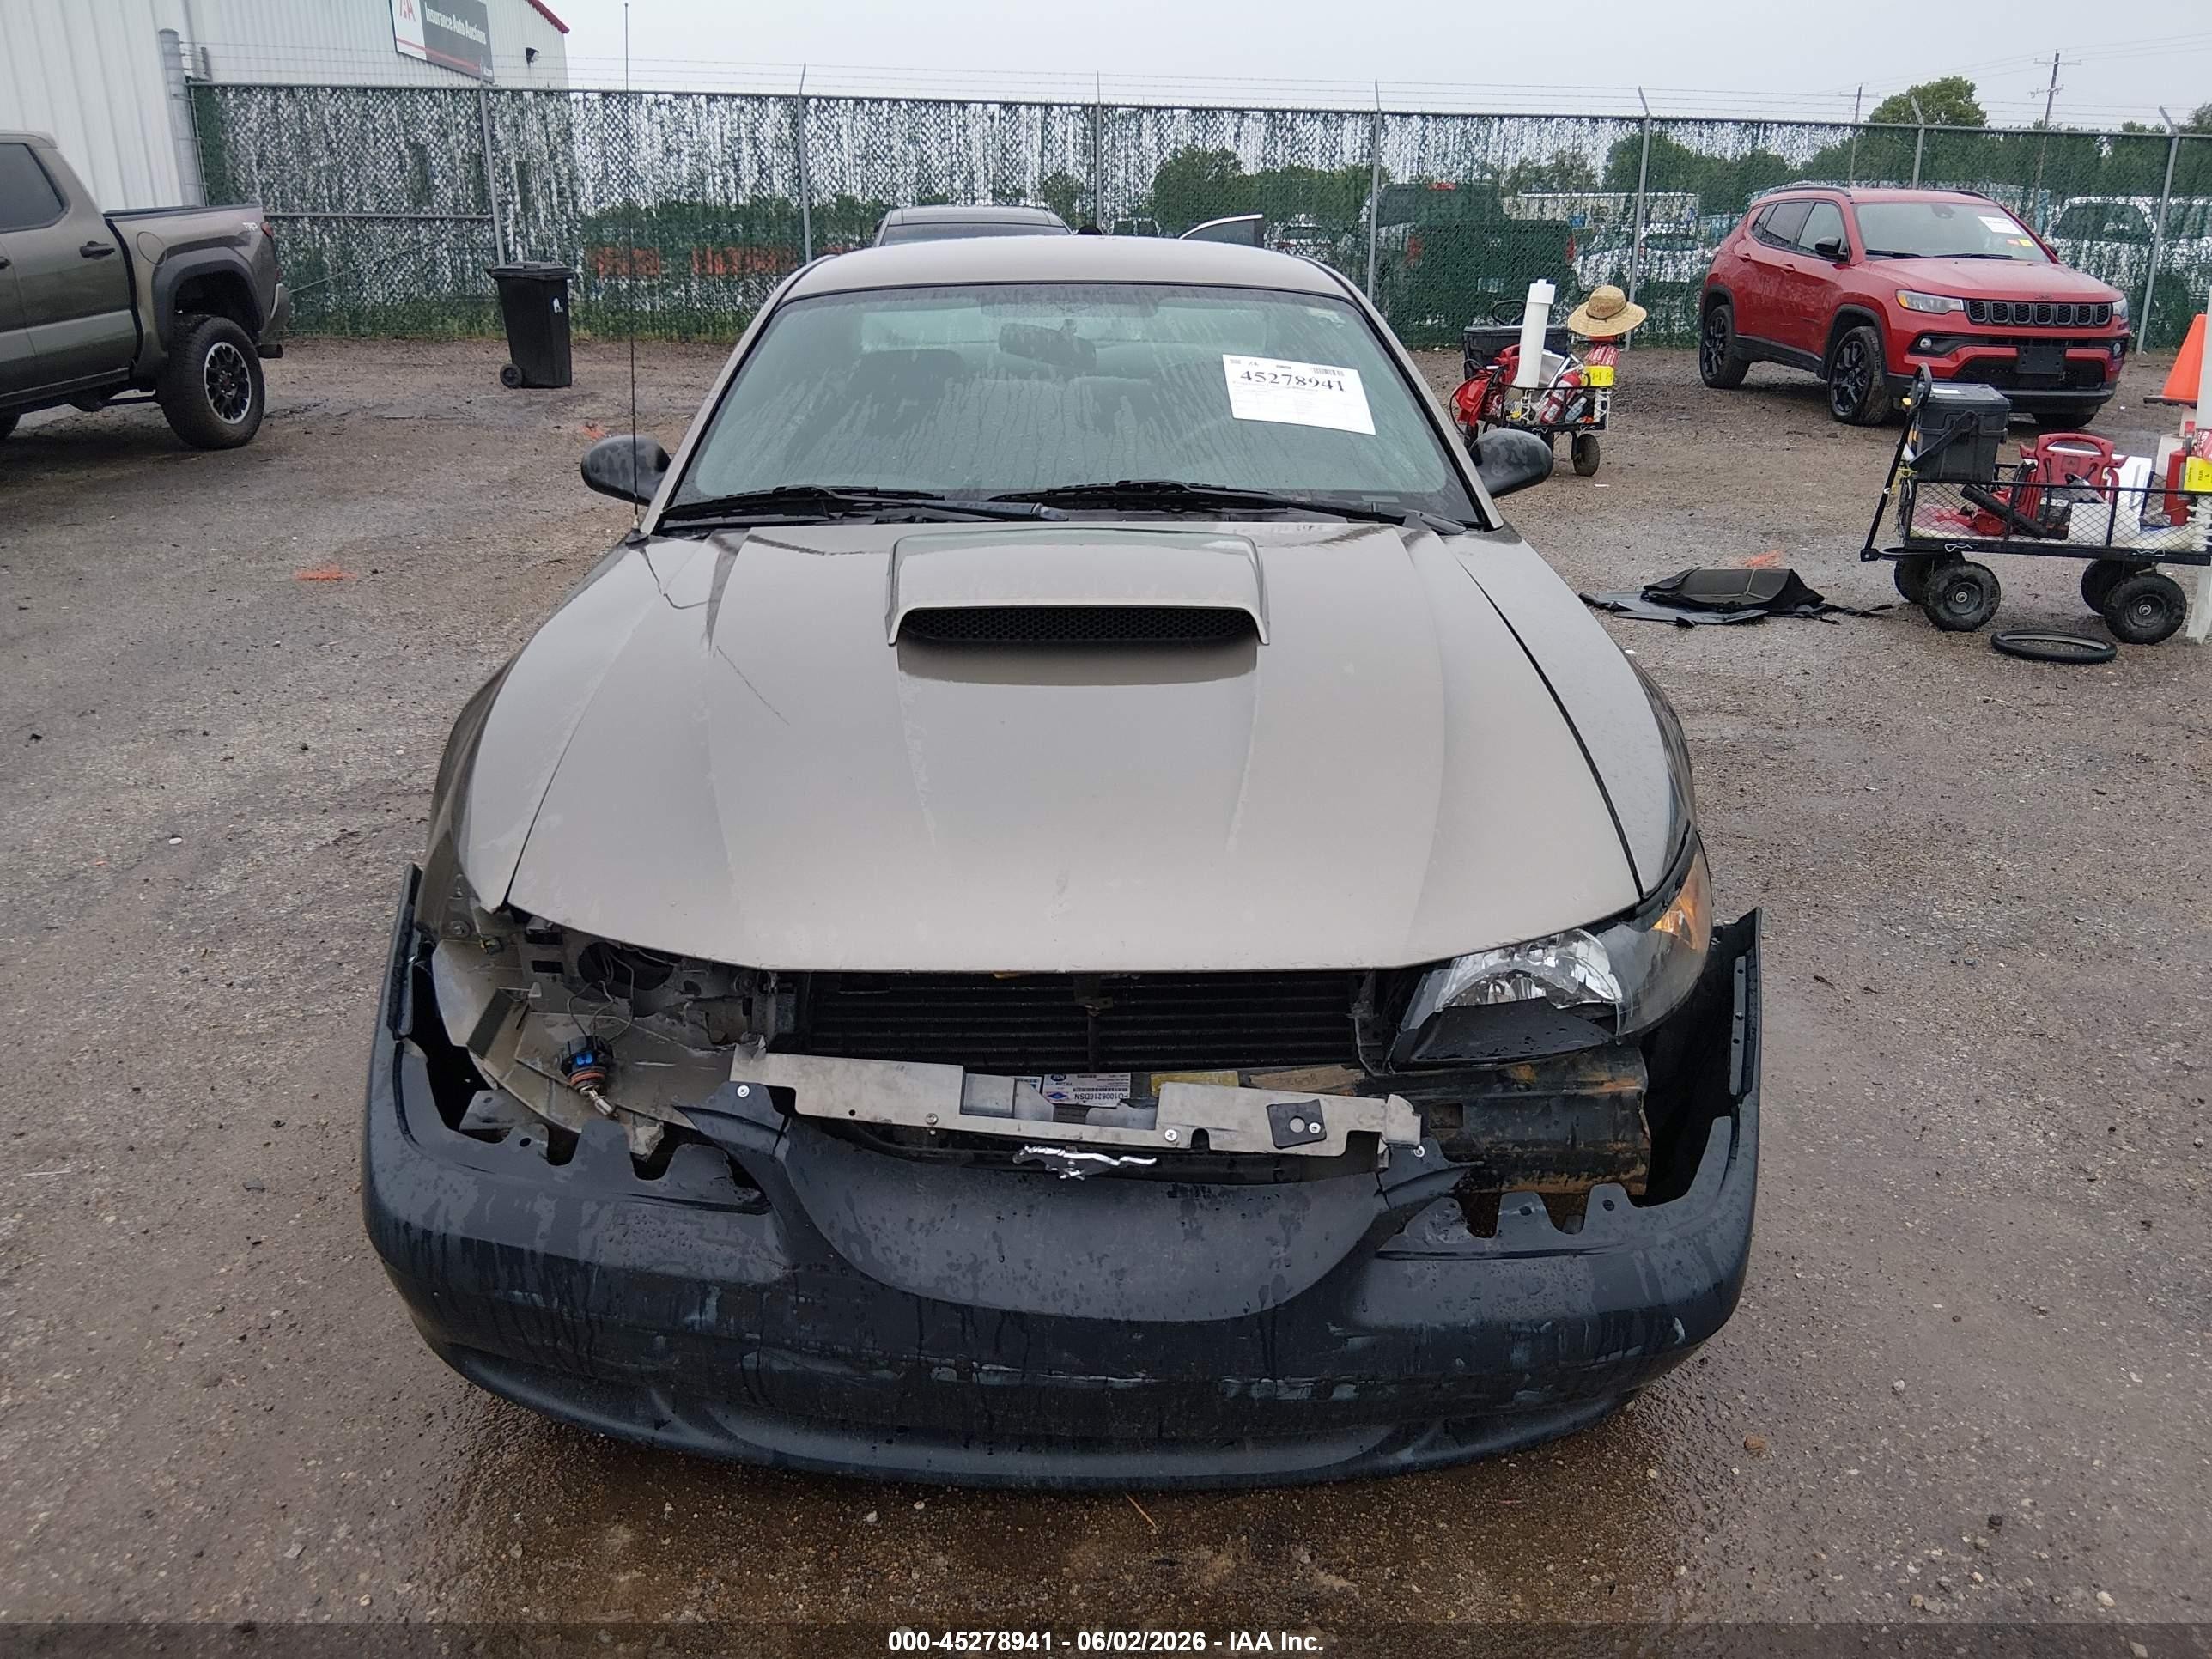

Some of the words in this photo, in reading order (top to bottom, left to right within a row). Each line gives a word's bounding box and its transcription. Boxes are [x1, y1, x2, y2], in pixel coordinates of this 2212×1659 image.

[424, 1, 453, 32] Insurance
[453, 14, 465, 37] Auto
[465, 20, 487, 45] Auctions
[1240, 370, 1346, 392] 45278941
